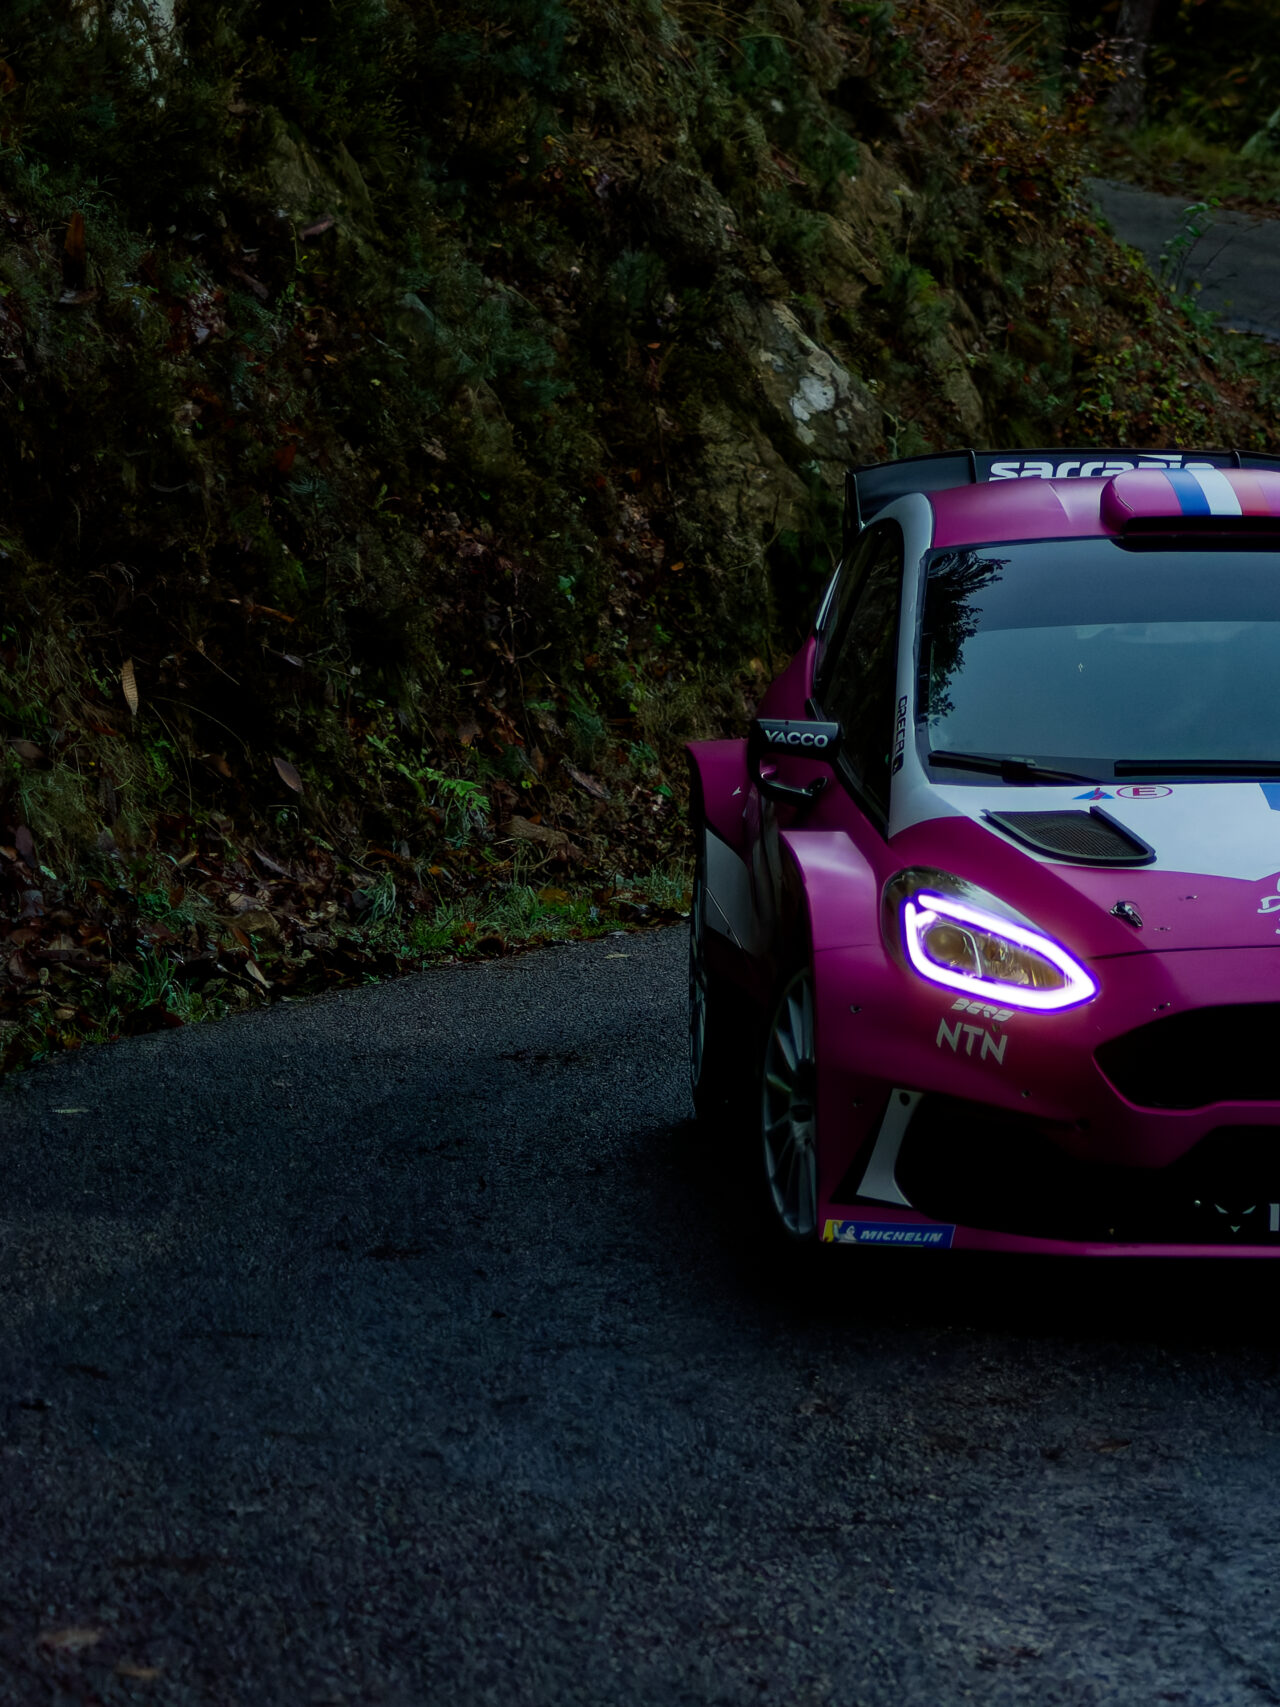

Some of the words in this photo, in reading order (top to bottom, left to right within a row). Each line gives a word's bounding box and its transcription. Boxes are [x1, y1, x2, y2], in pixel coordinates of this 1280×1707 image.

[765, 729, 829, 748] YACCO
[936, 1017, 1009, 1066] NTN
[860, 1230, 943, 1243] MICHELIN
